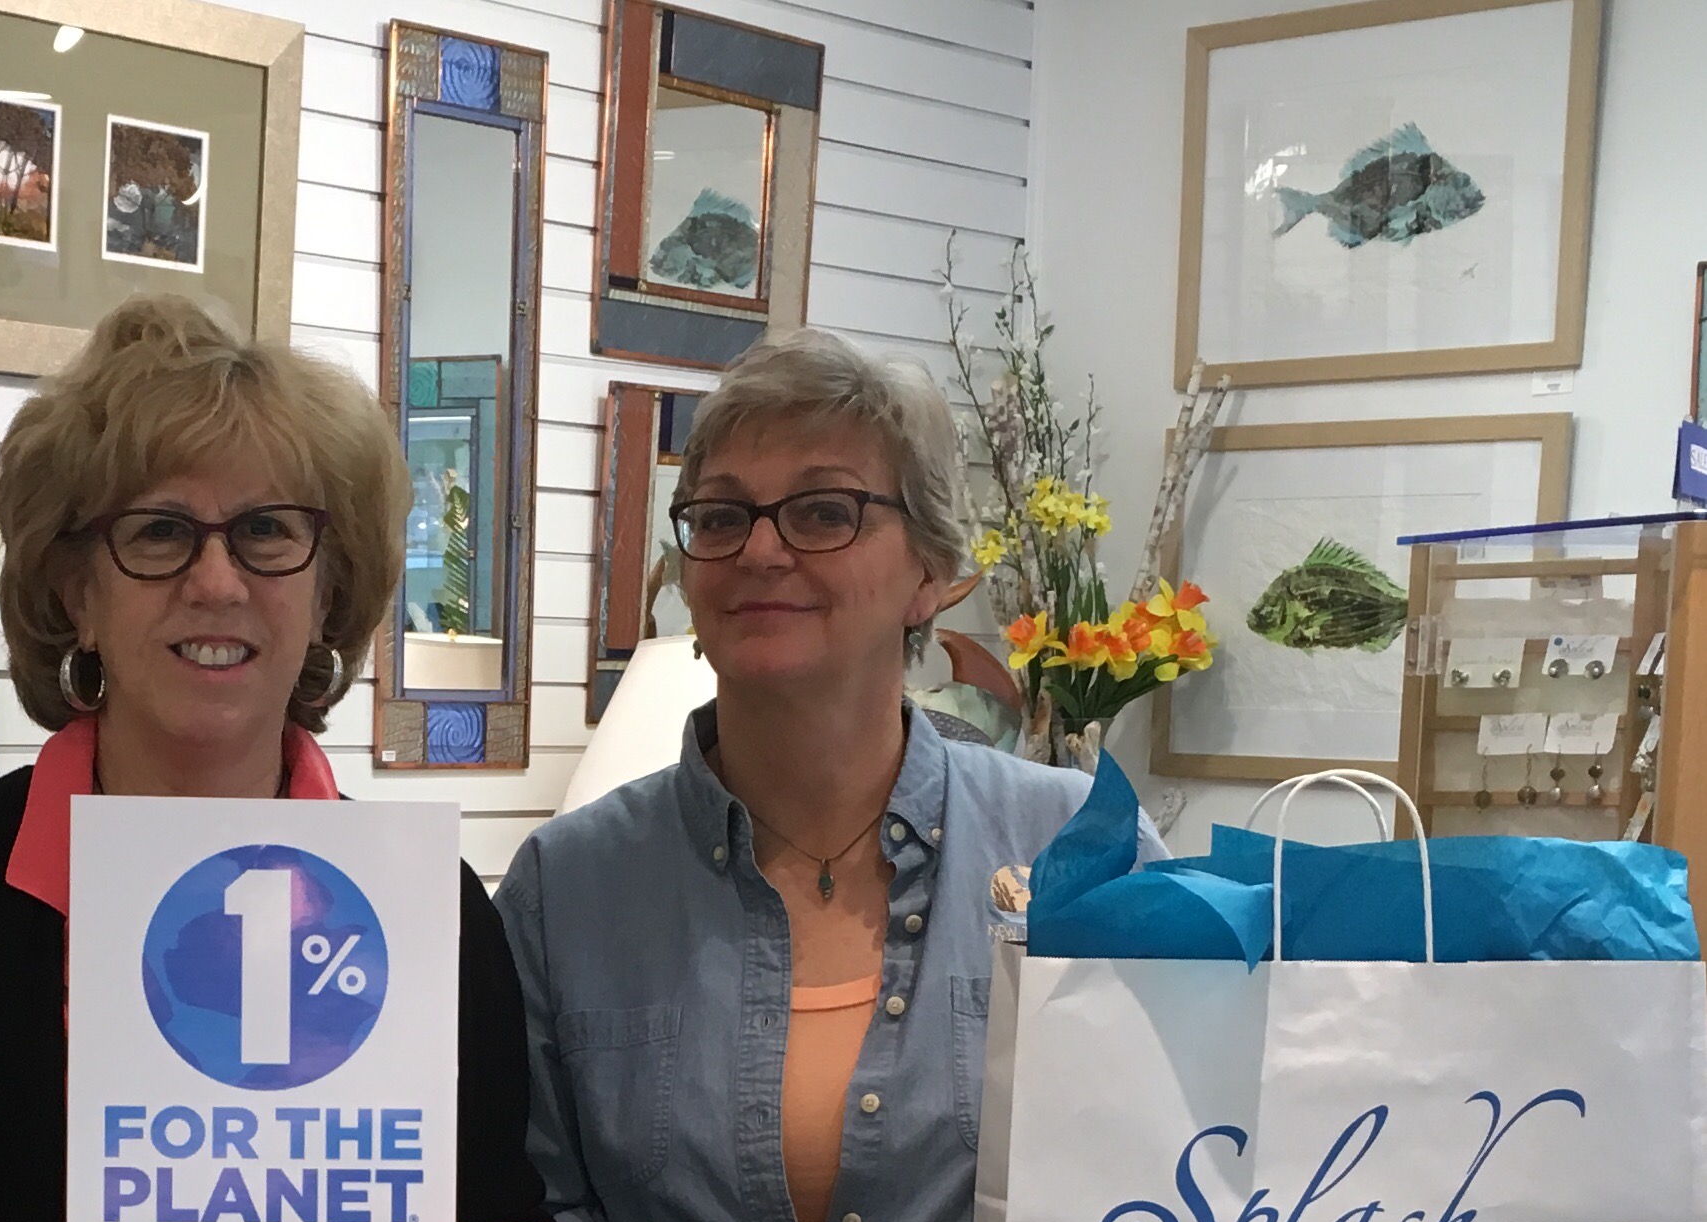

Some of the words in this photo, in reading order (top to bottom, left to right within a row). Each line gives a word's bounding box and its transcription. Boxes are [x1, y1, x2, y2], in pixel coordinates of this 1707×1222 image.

[223, 868, 367, 1065] 1%
[104, 1105, 258, 1160] FOR
[275, 1107, 423, 1161] THE
